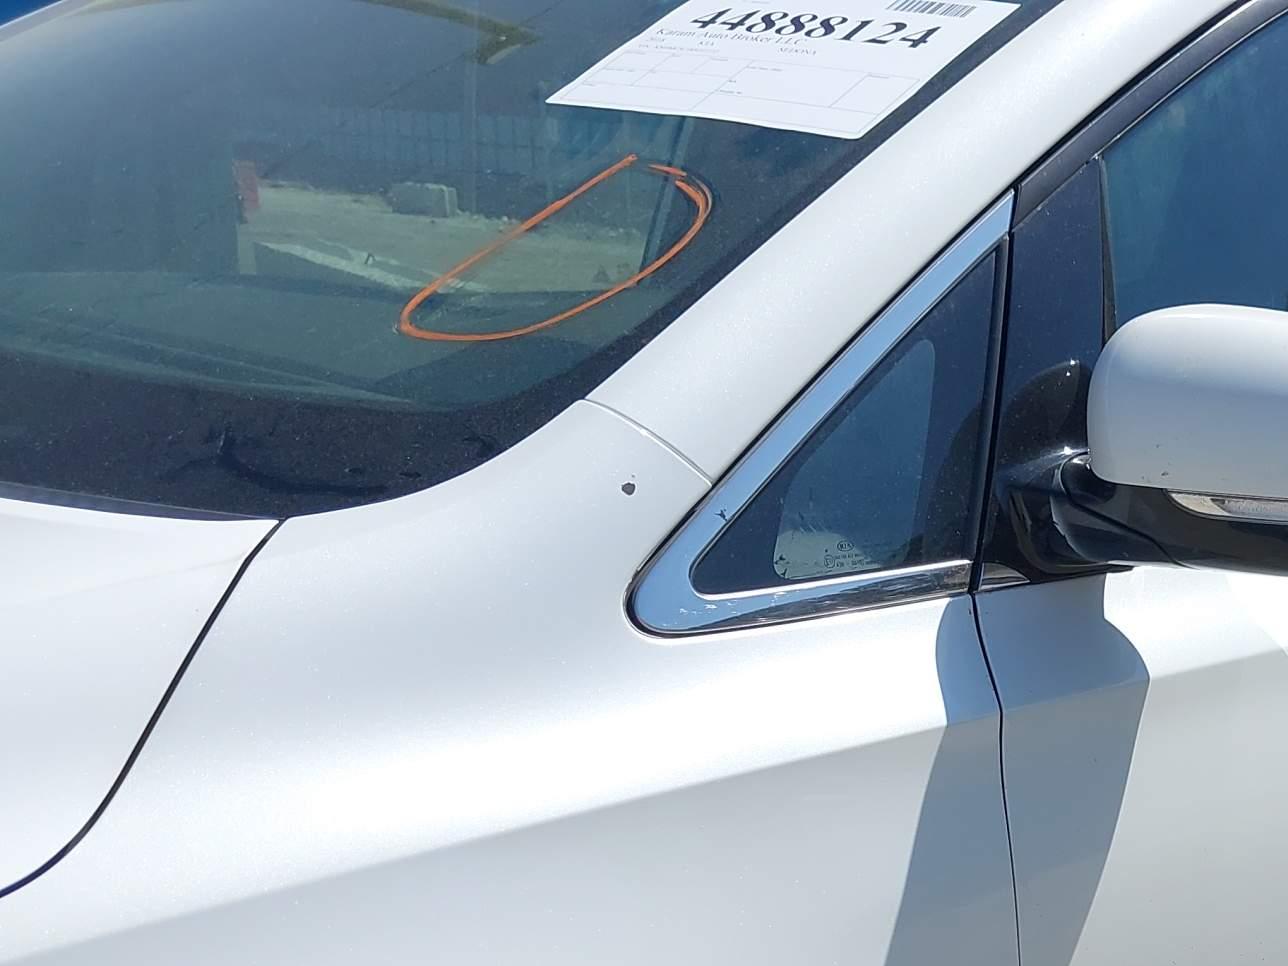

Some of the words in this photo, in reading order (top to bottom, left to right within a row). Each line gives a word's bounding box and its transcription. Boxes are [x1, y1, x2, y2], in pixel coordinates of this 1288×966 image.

[690, 8, 941, 48] 44888124
[699, 31, 729, 39] Auto
[731, 33, 771, 42] Broker
[775, 36, 808, 45] LLC
